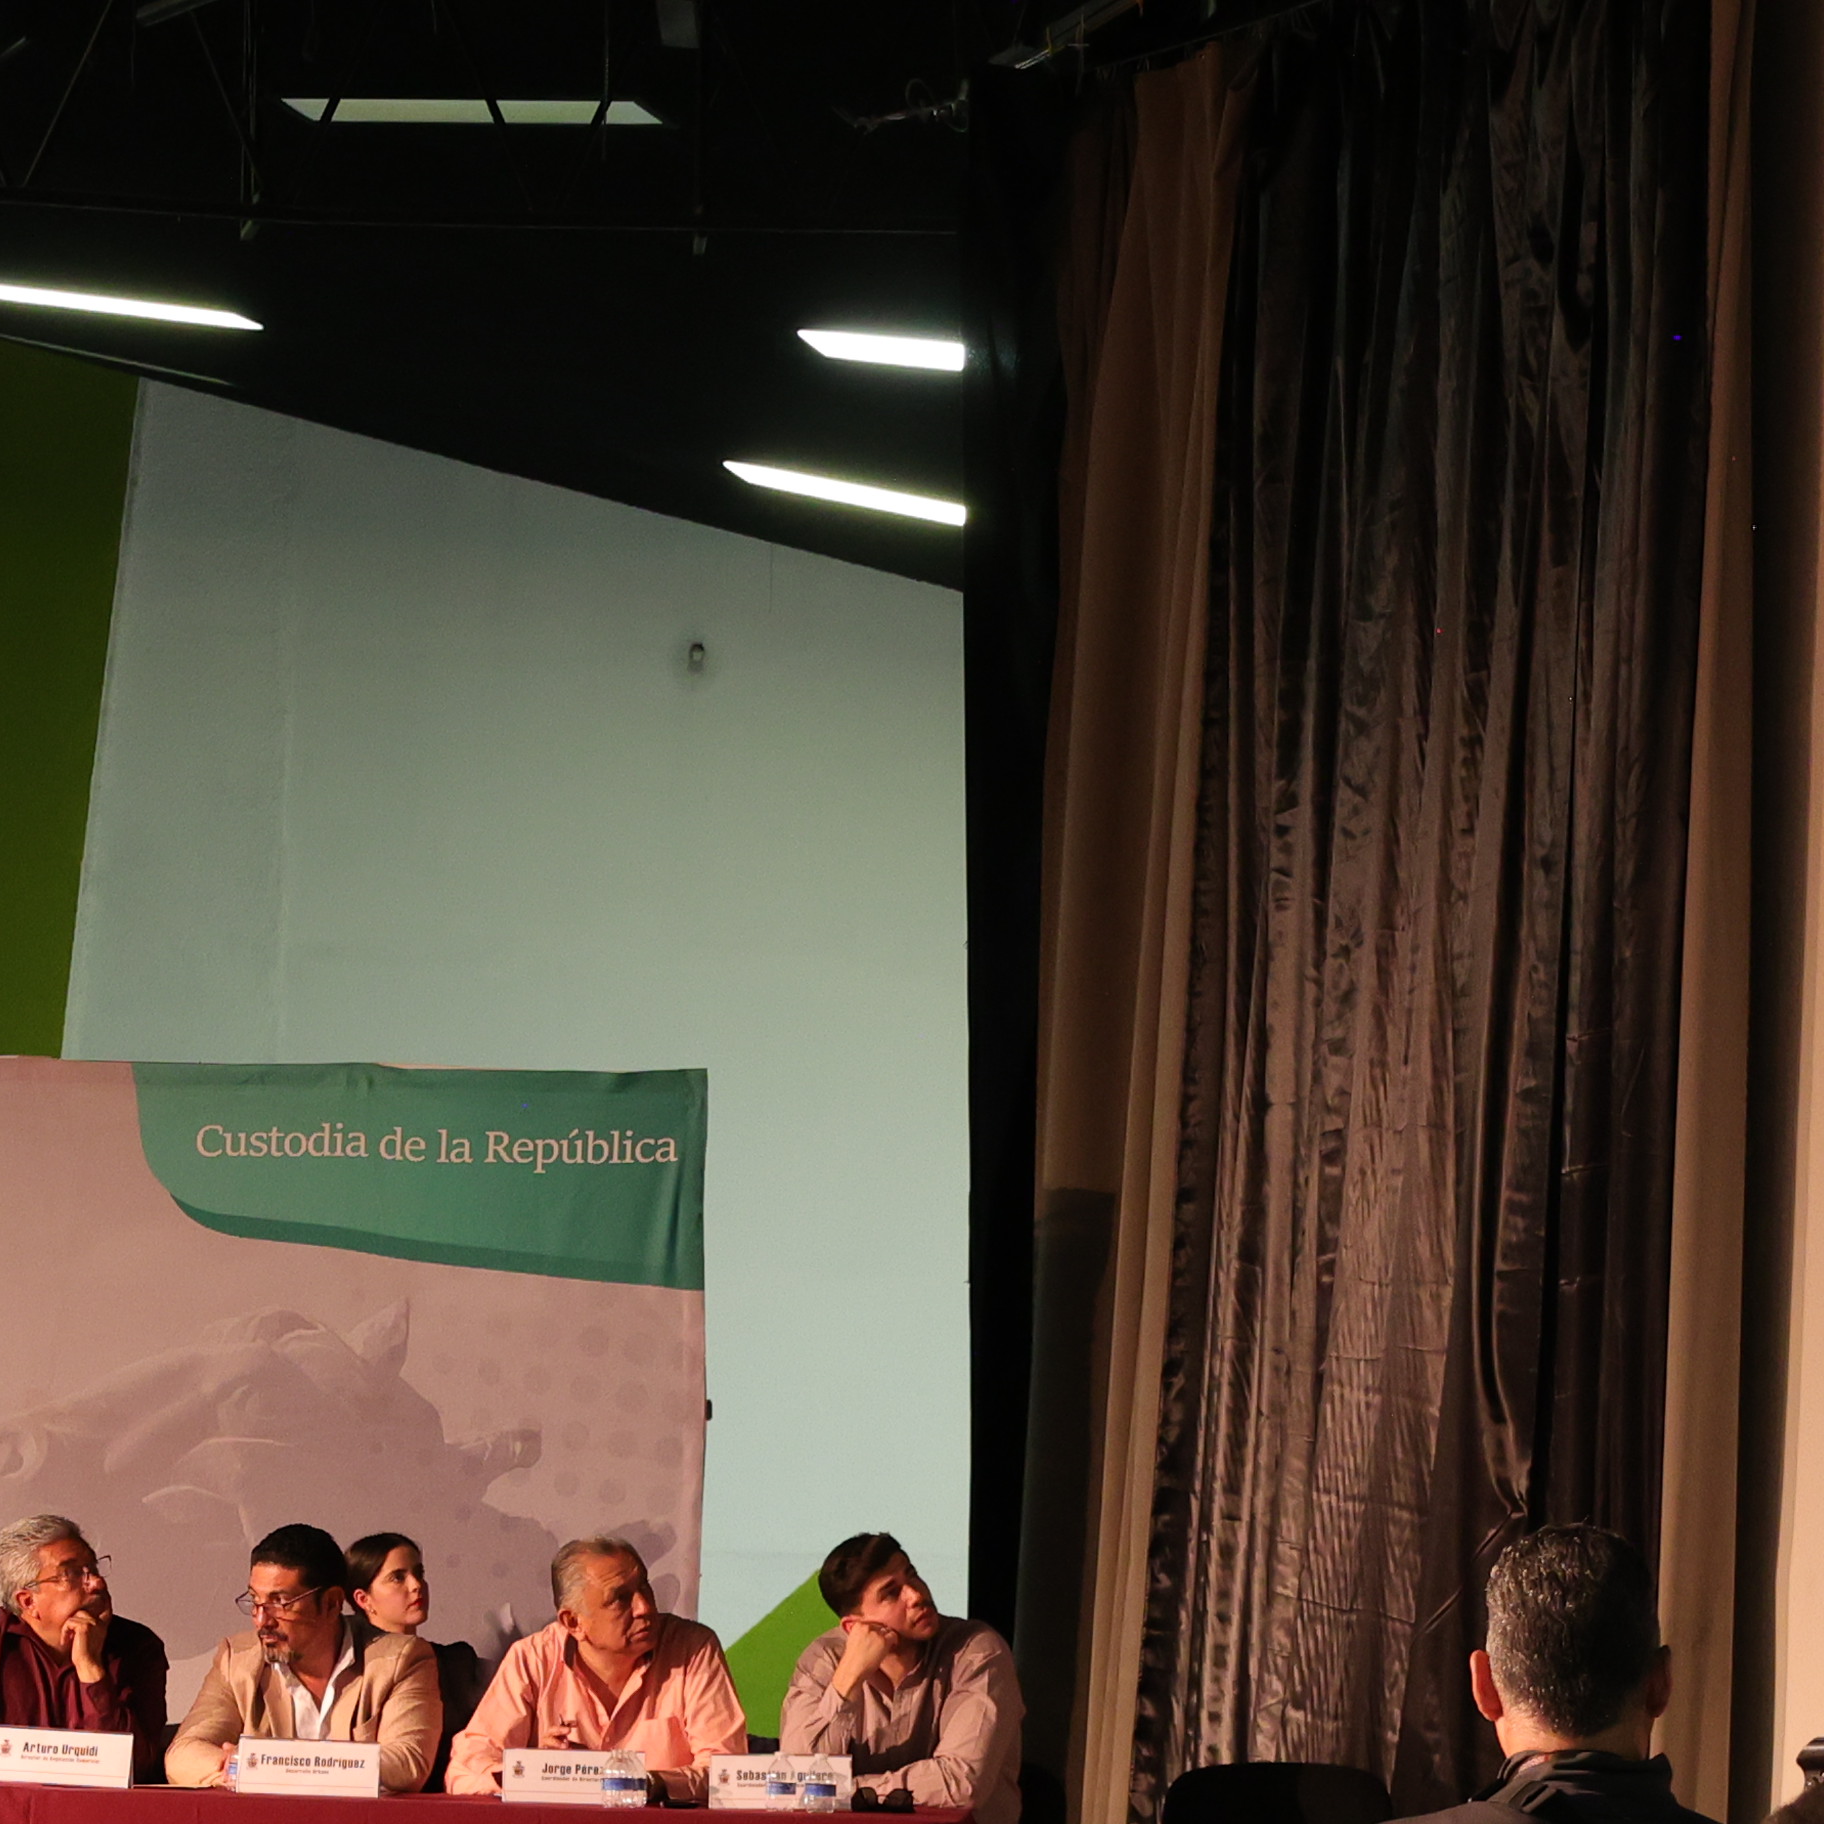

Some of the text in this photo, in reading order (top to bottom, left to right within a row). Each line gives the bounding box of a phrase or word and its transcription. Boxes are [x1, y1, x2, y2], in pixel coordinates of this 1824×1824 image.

[196, 1122, 678, 1174] Custodia de la República
[23, 1742, 98, 1757] Arturo Urquidi
[261, 1754, 311, 1767] Francisco
[542, 1763, 572, 1776] Jorge
